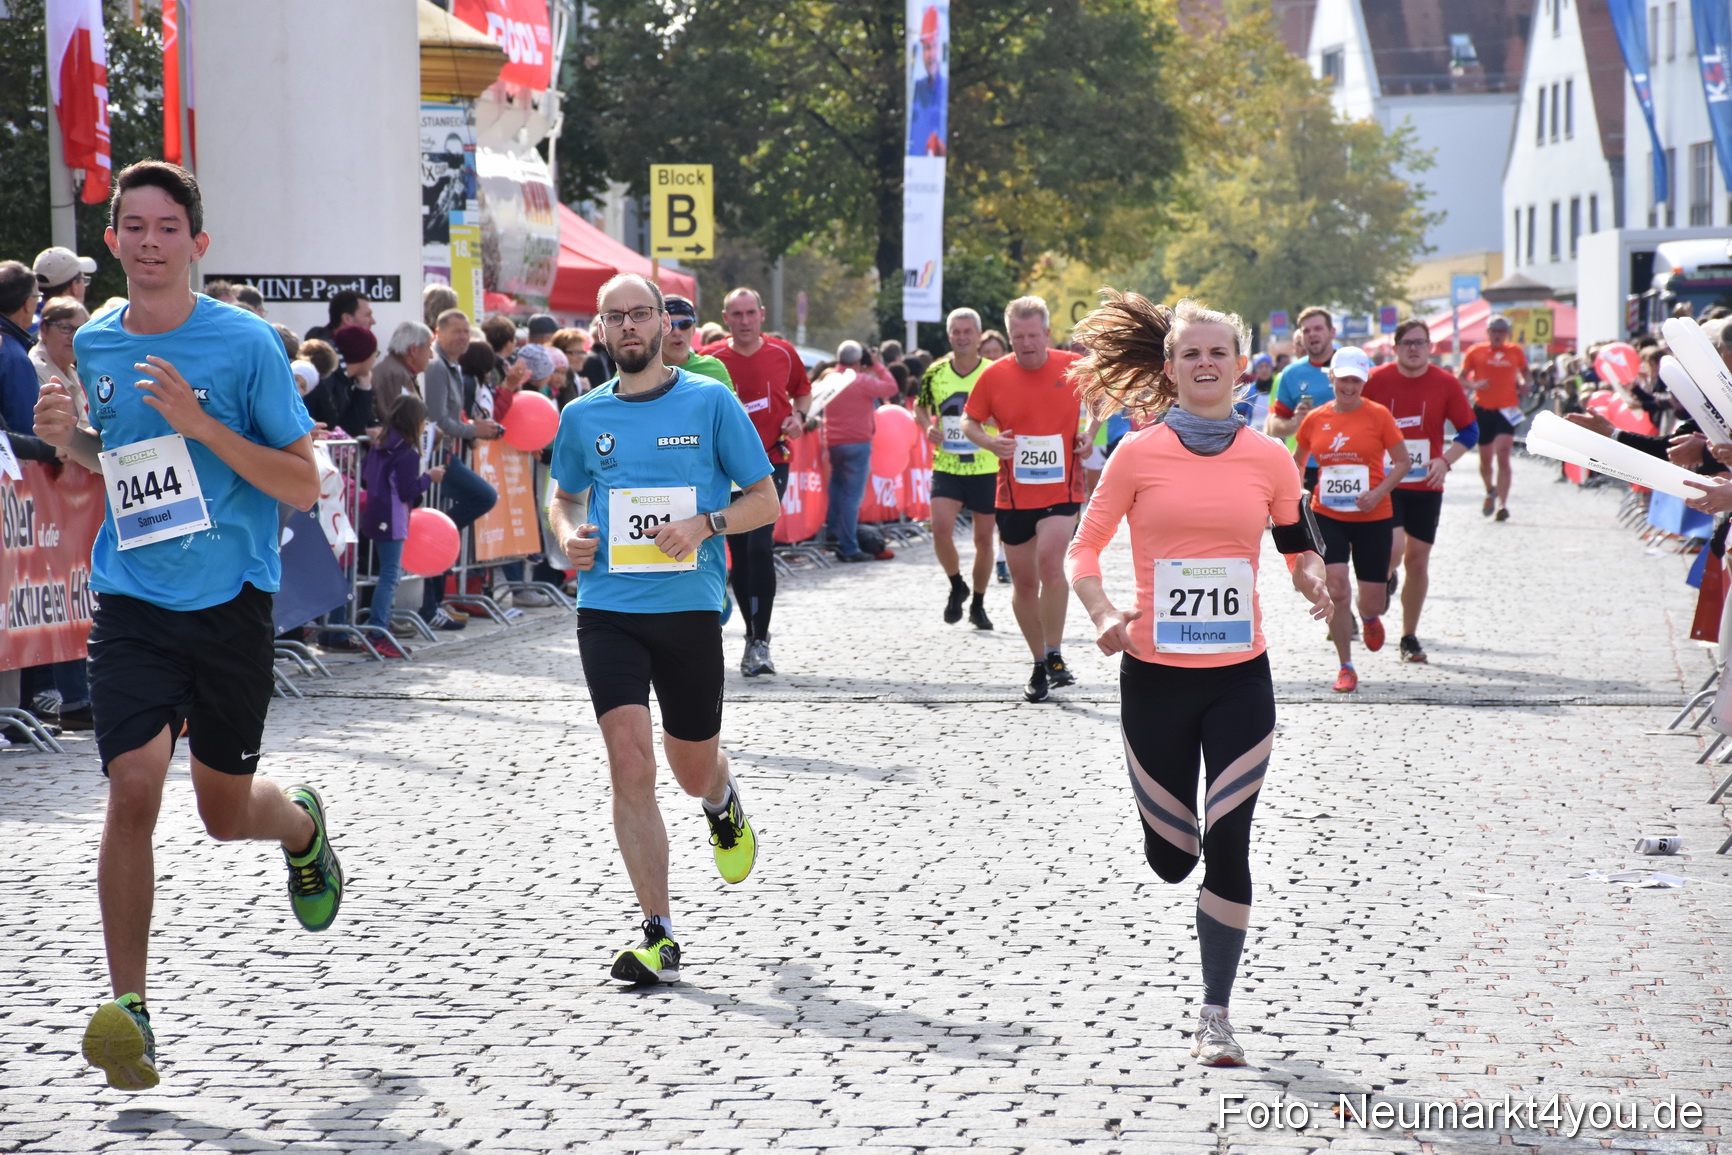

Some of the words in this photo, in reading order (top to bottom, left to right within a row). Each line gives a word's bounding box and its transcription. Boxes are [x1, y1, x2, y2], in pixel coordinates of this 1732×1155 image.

[658, 168, 705, 186] Block
[667, 193, 697, 238] B
[1535, 318, 1550, 337] D
[657, 435, 700, 447] BOCK
[125, 448, 158, 463] BOCK
[1021, 450, 1057, 465] 2540
[117, 465, 182, 510] 2444
[1326, 479, 1361, 494] 2564
[640, 496, 670, 504] BOCK
[138, 509, 172, 528] Samuel
[1193, 567, 1227, 576] BOCK
[1169, 587, 1240, 617] 2716
[1181, 624, 1227, 642] Hanna
